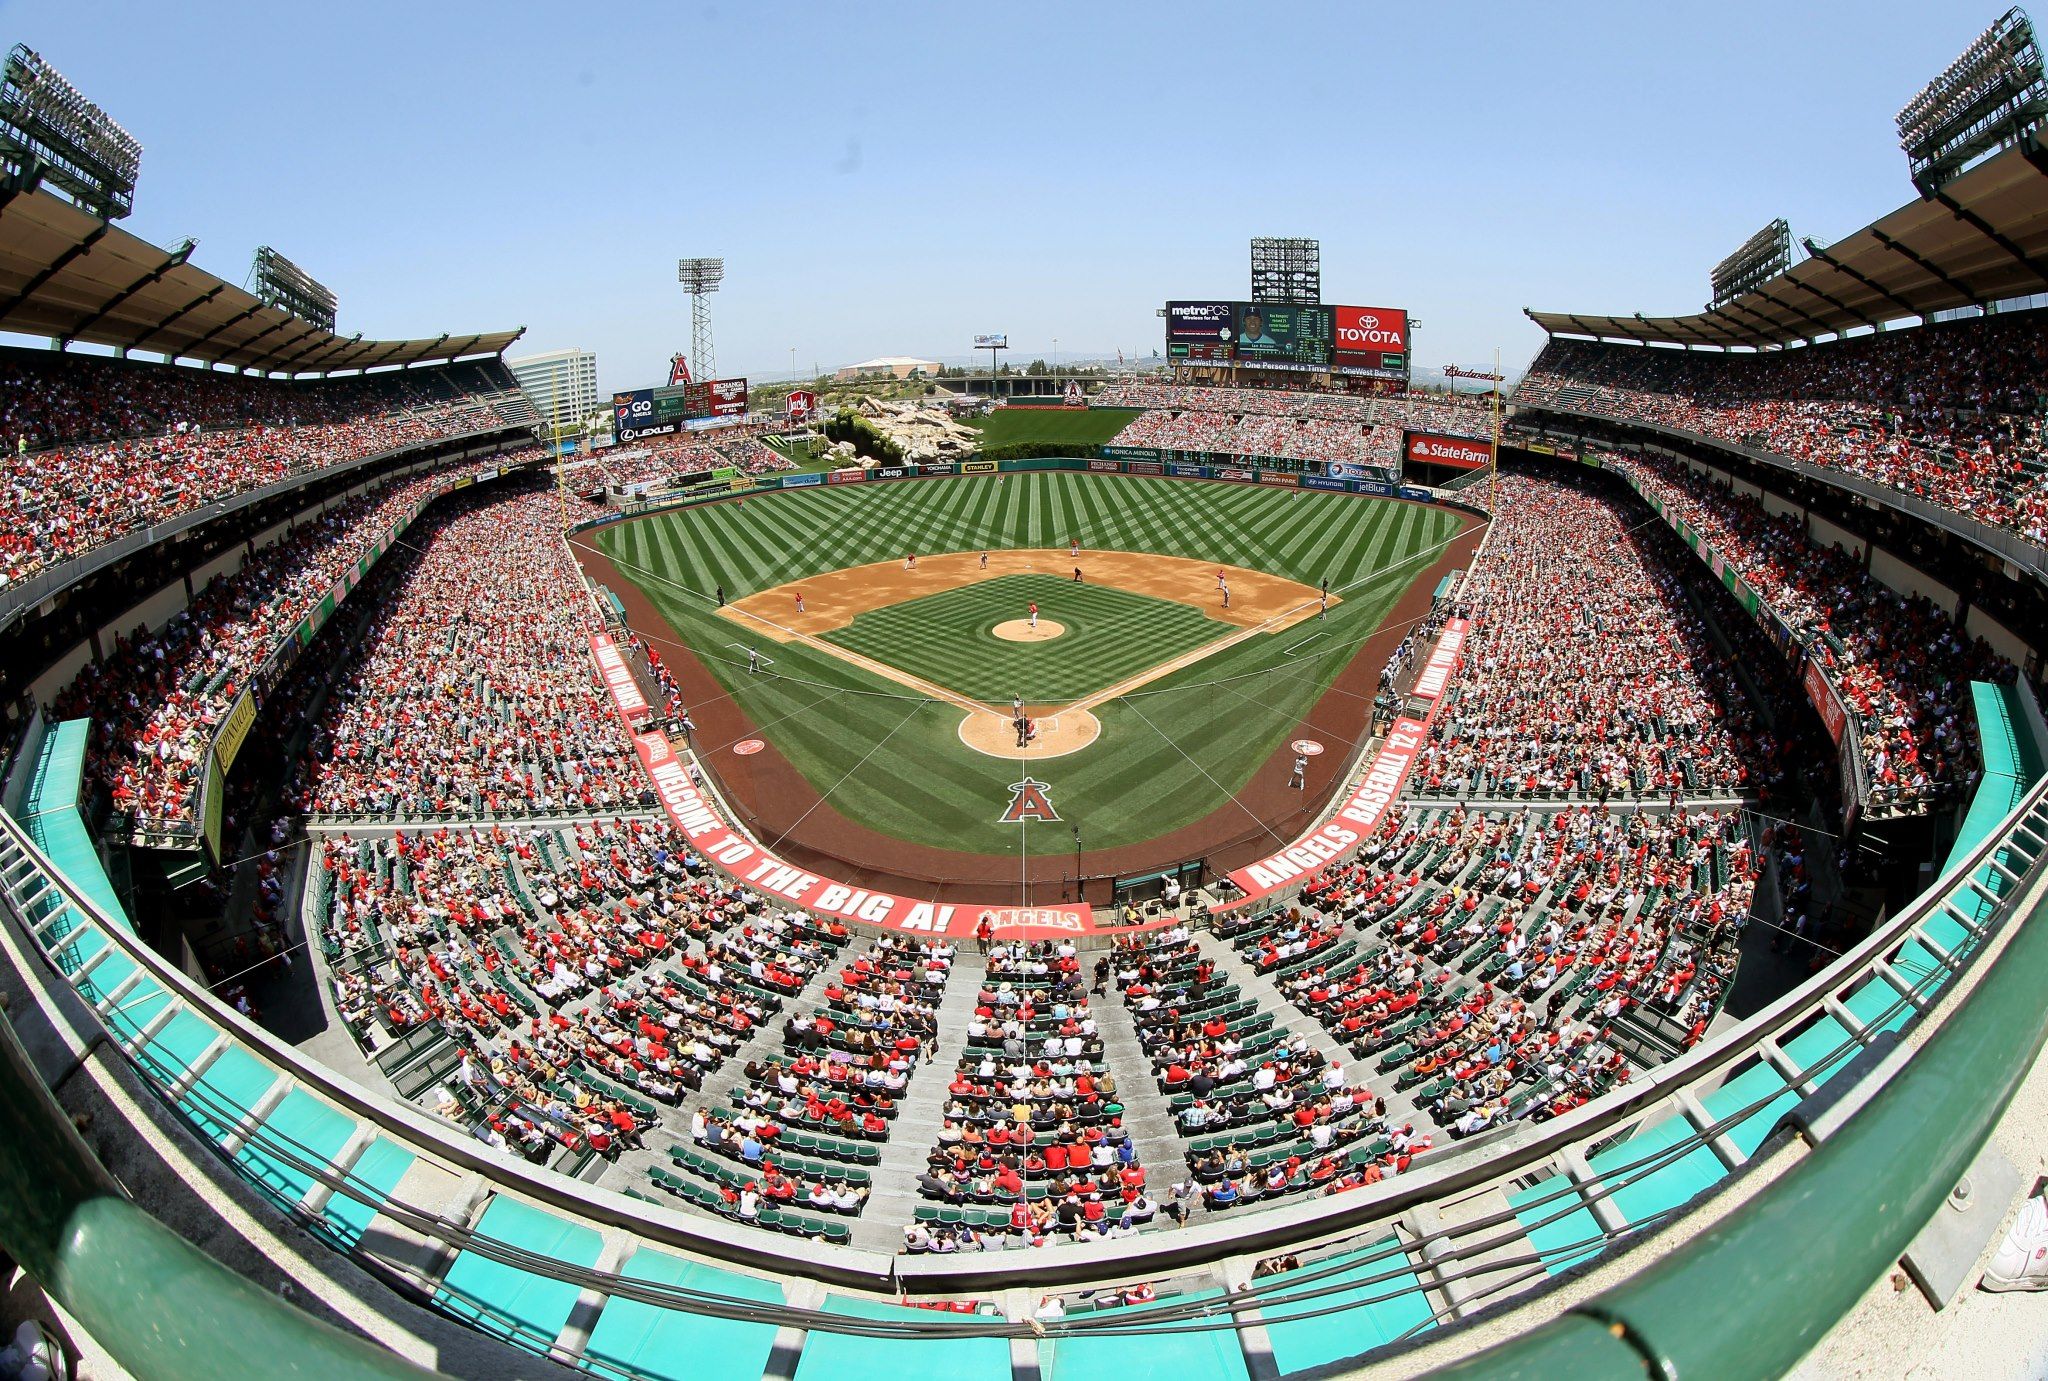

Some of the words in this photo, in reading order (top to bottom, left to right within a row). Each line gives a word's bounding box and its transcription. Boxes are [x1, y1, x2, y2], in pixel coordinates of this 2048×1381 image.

[1338, 328, 1401, 344] TOYOTA
[1182, 359, 1212, 367] OneWest
[1212, 360, 1230, 368] Bank
[1245, 361, 1260, 369] One
[1262, 362, 1289, 371] Person
[1307, 365, 1327, 373] Time
[1342, 367, 1373, 376] OneWest
[1374, 369, 1392, 378] Bank
[1443, 365, 1506, 381] Budweiser
[632, 400, 651, 412] GO
[715, 401, 745, 411] EXPERIENCE
[635, 424, 675, 437] LEXUS
[880, 468, 903, 479] Jeep
[1359, 483, 1385, 493] jetBlue
[1341, 752, 1410, 826] BASEBALL
[997, 776, 1064, 823] A
[651, 761, 723, 839] WELCOME
[706, 834, 755, 865] TO
[745, 857, 821, 900] THE
[813, 883, 896, 924] BIG
[900, 902, 956, 933] A!
[1246, 823, 1359, 889] ANGELS
